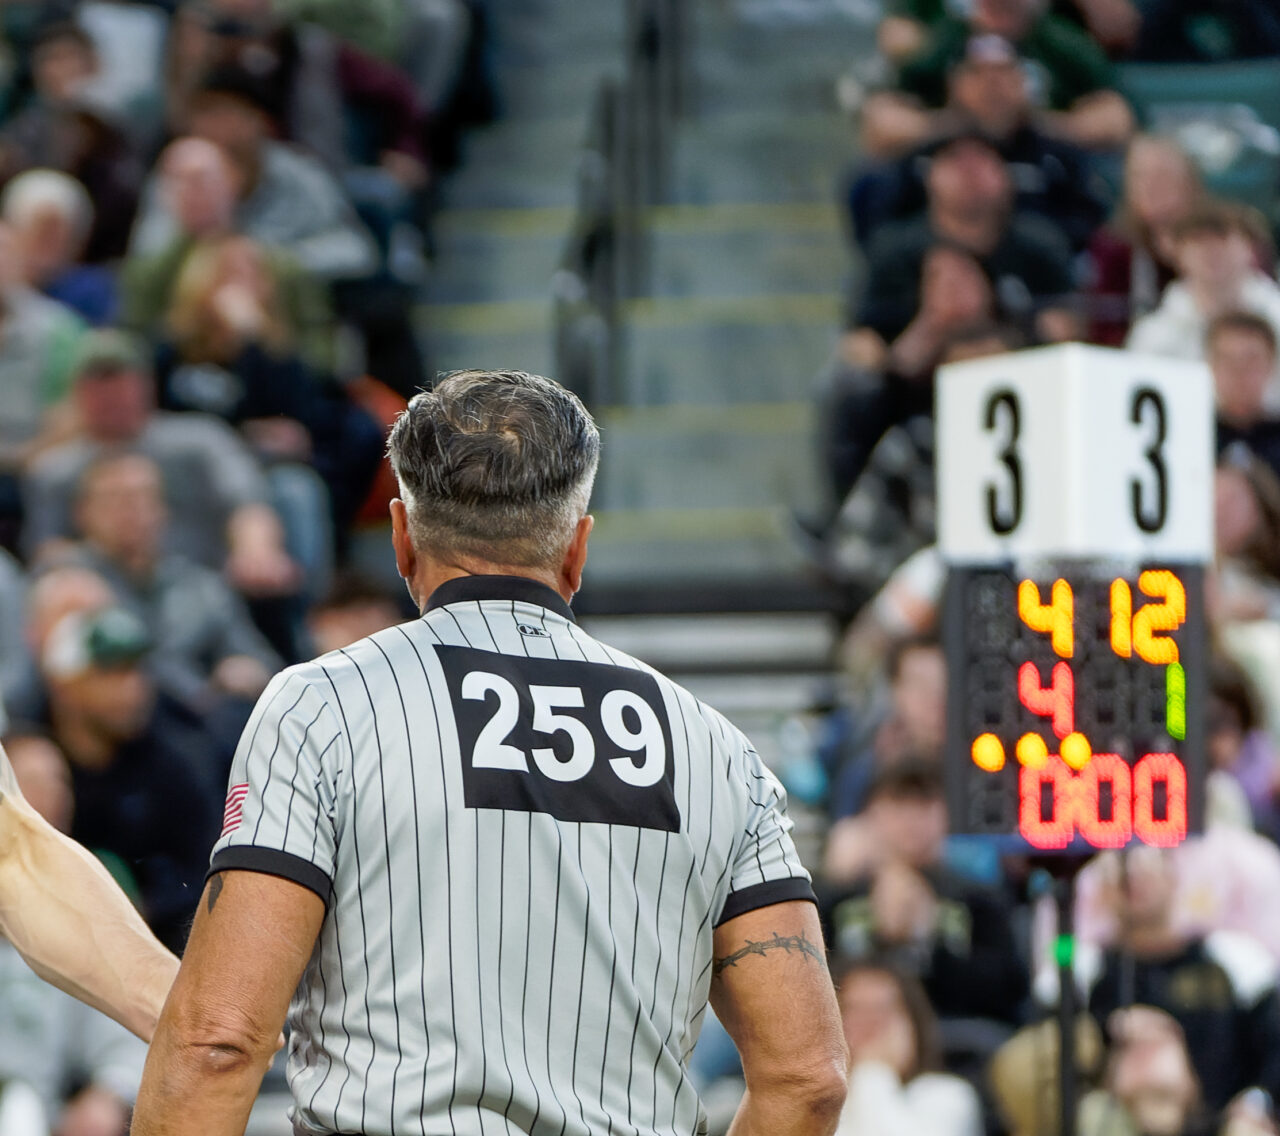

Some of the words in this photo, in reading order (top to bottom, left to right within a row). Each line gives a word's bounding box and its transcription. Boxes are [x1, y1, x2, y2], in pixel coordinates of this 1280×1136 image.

[984, 385, 1023, 537] 3
[1130, 384, 1168, 535] 3
[1018, 578, 1074, 659] 4
[1110, 569, 1186, 665] 12
[461, 671, 666, 788] 259
[1018, 661, 1074, 741] 4
[1166, 661, 1186, 741] 1
